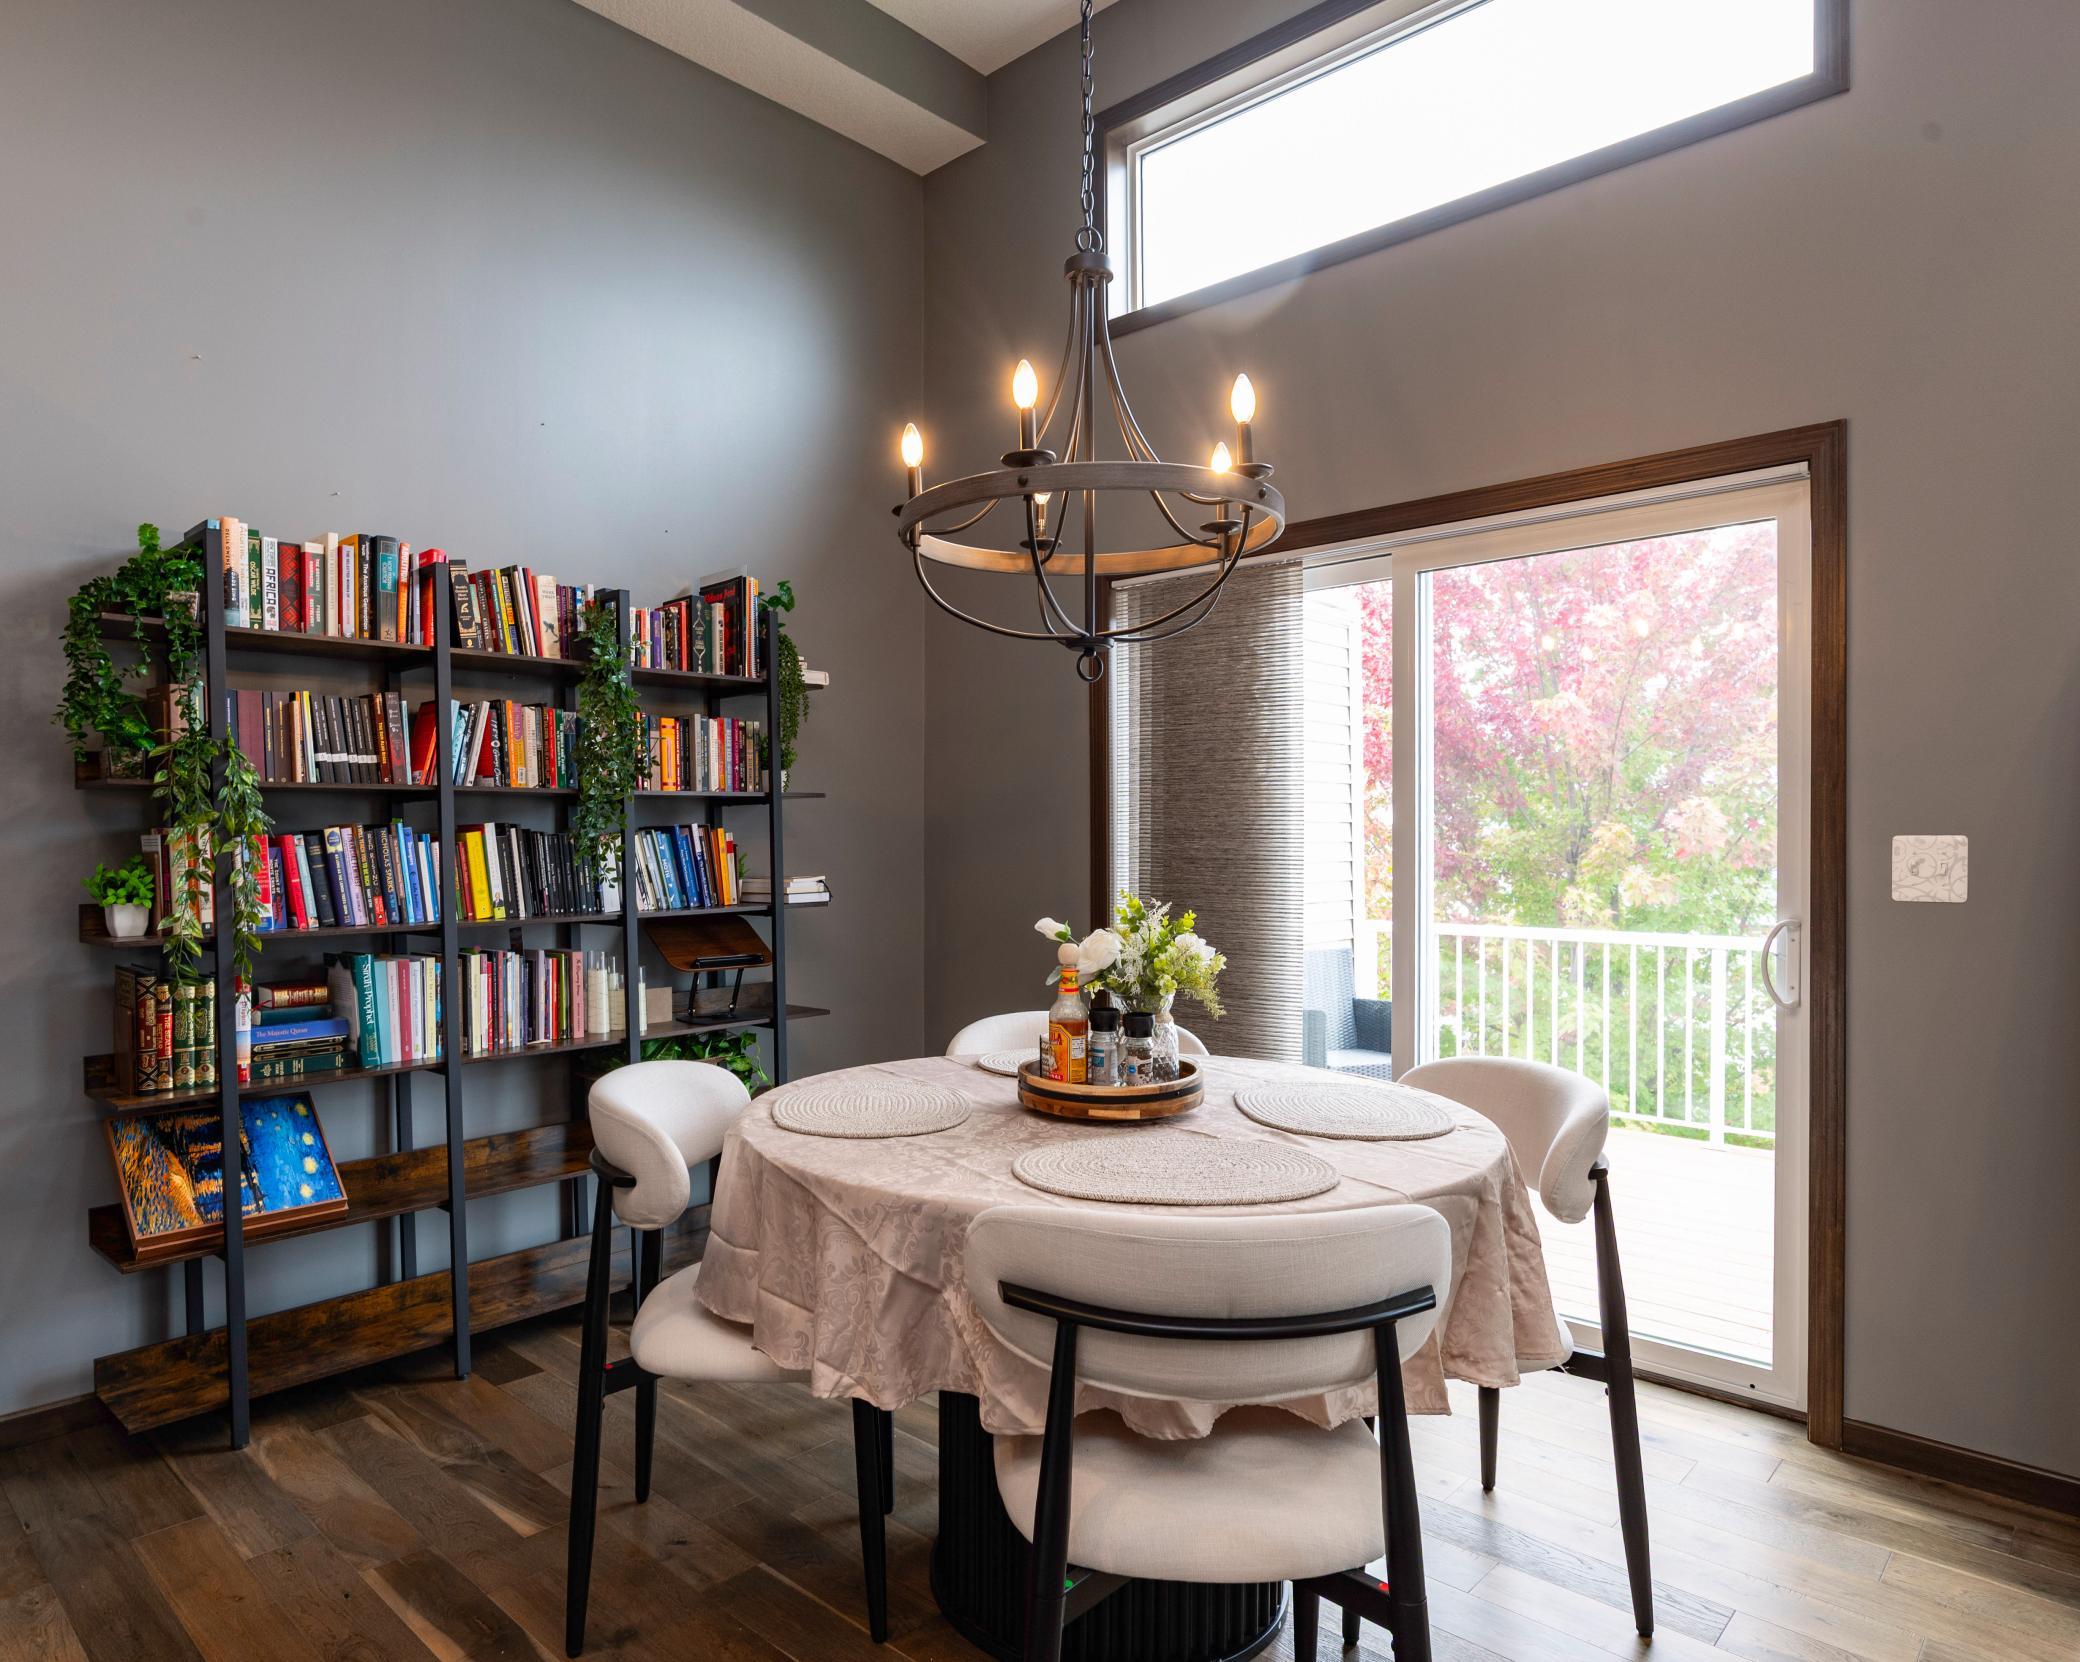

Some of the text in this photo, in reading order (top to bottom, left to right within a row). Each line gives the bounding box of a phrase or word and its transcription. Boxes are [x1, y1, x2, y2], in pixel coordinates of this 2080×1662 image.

[249, 561, 257, 596] OSCAR WILDE
[265, 568, 277, 605] AFRICA
[381, 830, 390, 867] NICHOLAS
[385, 869, 394, 893] SPARKS
[362, 964, 371, 988] Sirah
[363, 991, 375, 1024] Prophet
[267, 1029, 289, 1037] Majestic
